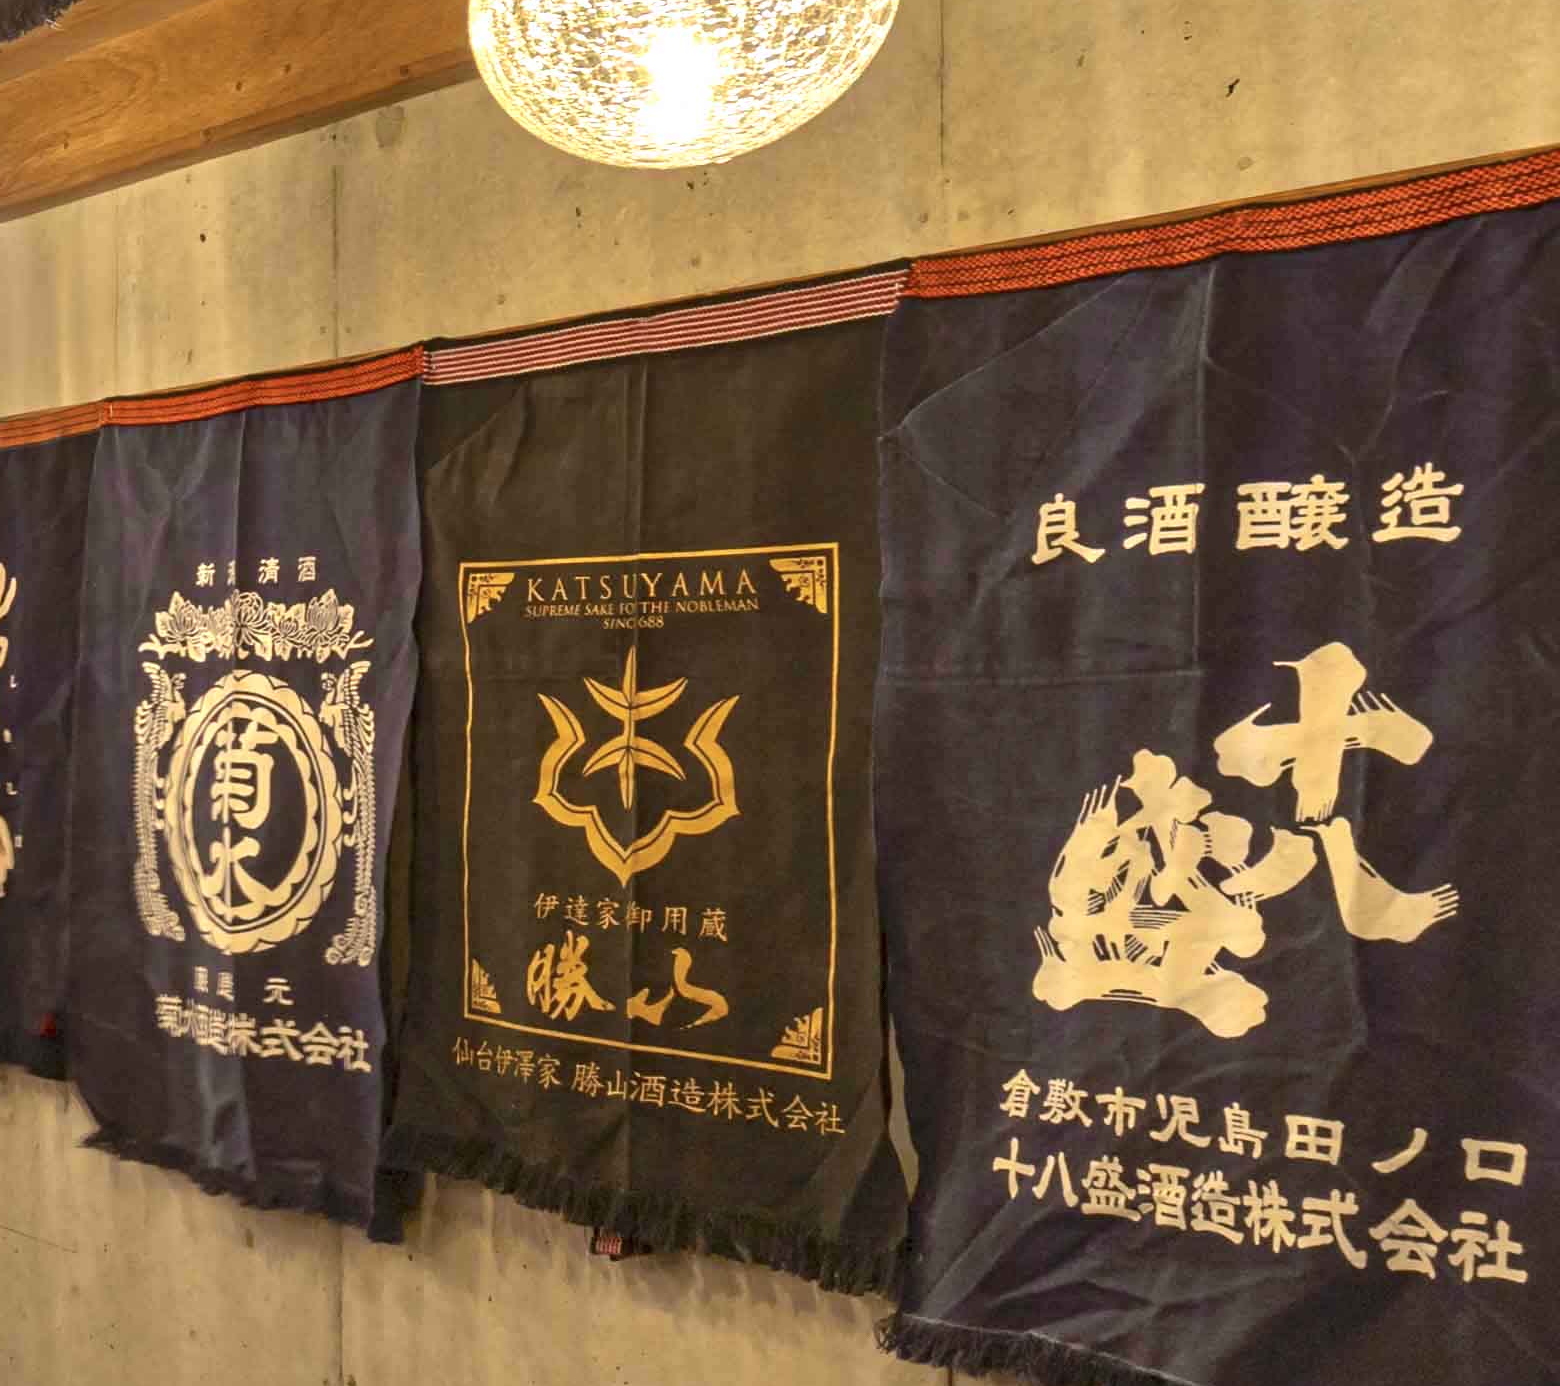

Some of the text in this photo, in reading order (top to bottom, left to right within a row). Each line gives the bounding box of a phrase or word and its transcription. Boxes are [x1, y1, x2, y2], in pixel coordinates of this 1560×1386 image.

[1031, 461, 1464, 566] 良酒醸造
[527, 567, 758, 603] KATSUYAMA
[584, 603, 616, 616] SAKE
[640, 601, 671, 614] THE
[674, 597, 760, 614] NOBLEMAN
[206, 719, 279, 914] 菊水
[535, 892, 728, 942] 伊達家御用蔵
[526, 930, 729, 1030] 勝山
[571, 1060, 846, 1135] 勝山酒造株式会社
[1000, 1069, 1528, 1188] 倉敷市児島田ノ口
[992, 1138, 1528, 1283] 十八盛酒造株式会社
